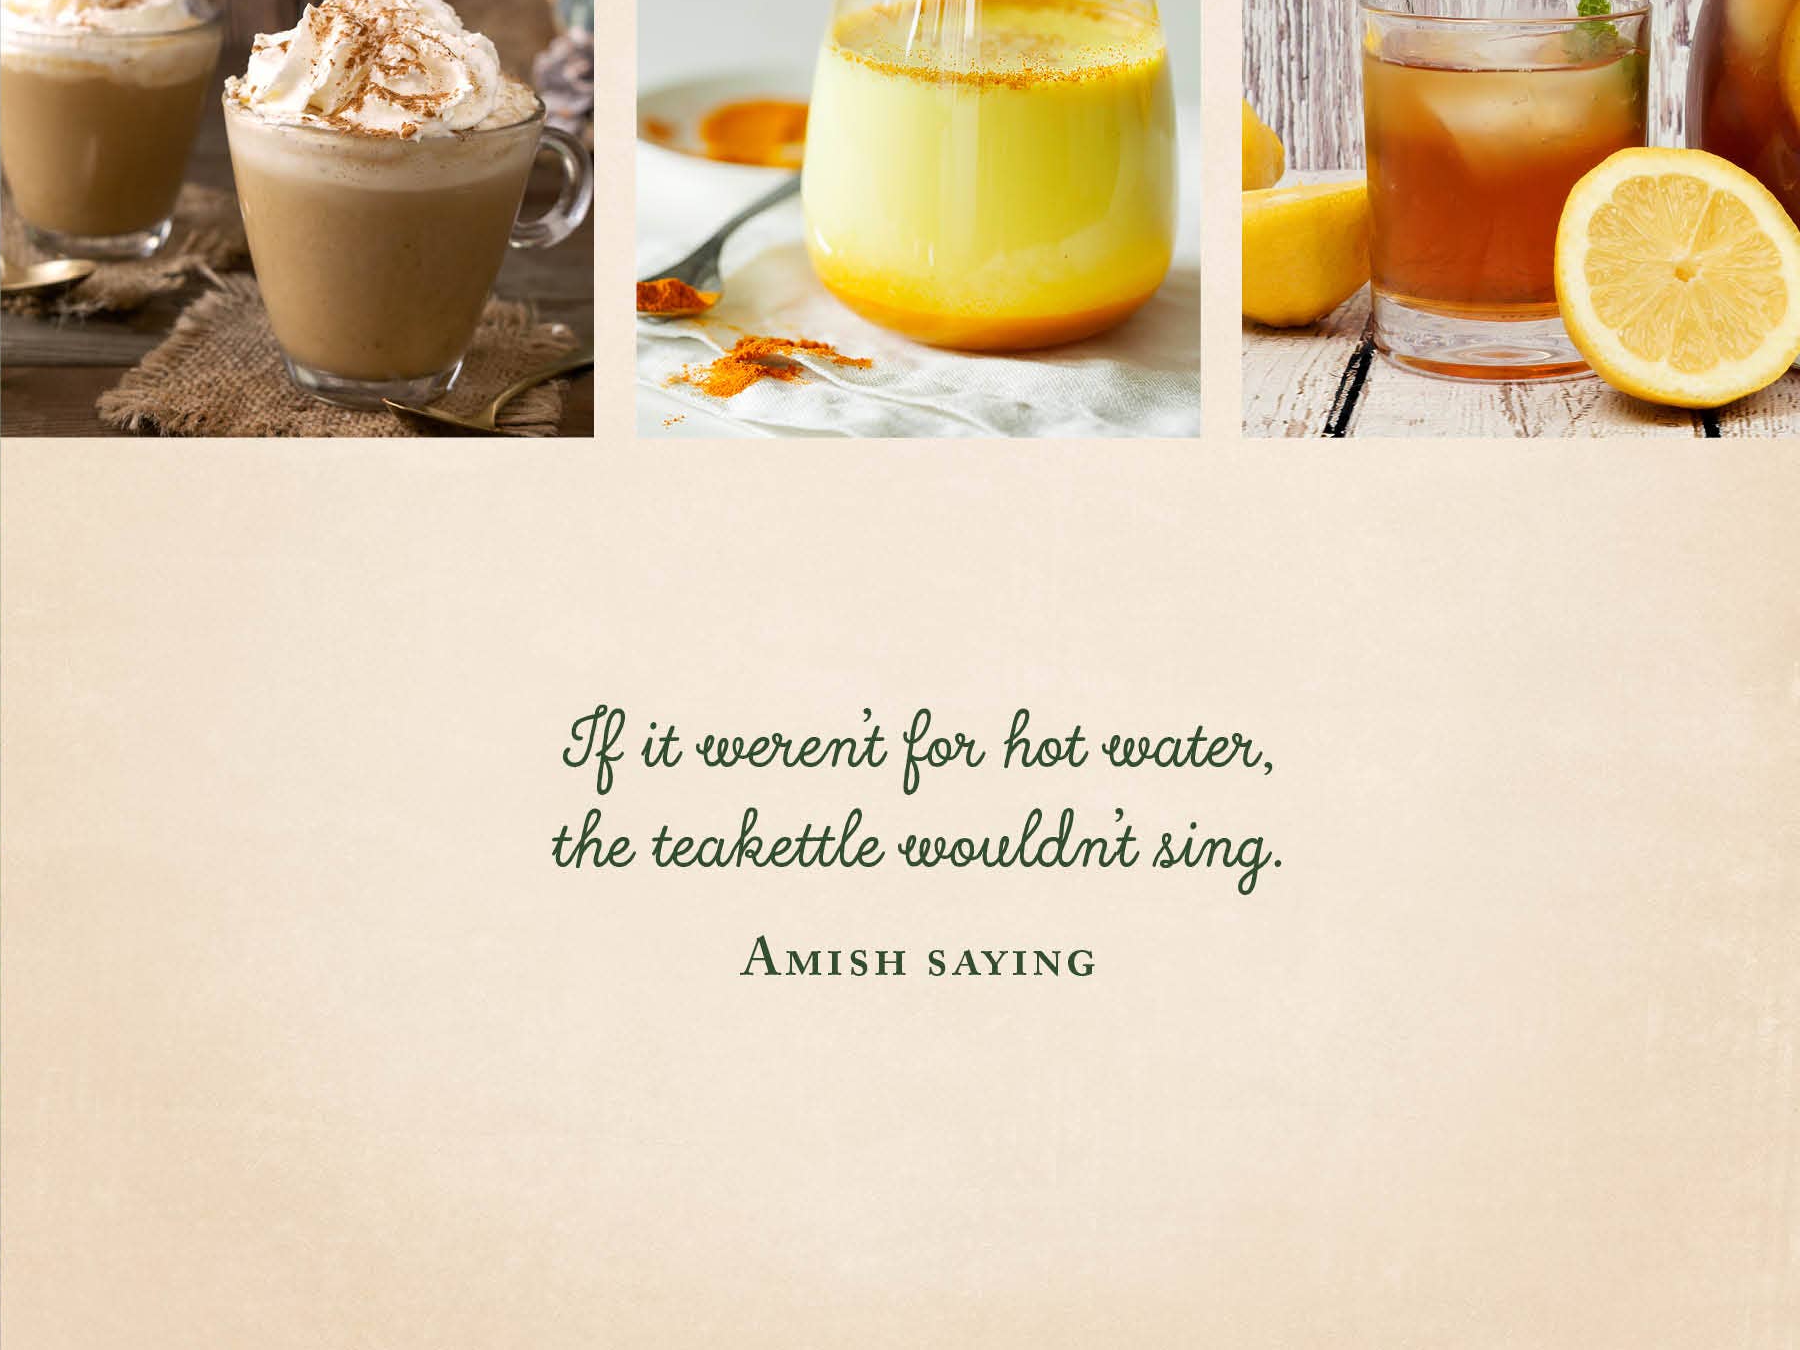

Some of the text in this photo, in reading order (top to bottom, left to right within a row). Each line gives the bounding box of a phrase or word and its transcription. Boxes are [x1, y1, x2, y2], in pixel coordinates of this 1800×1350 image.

[562, 704, 1273, 796] If it weren't for hot water,
[551, 807, 1282, 896] the teakettle wouldn't sing.
[739, 935, 1095, 977] AMISH SAYING
